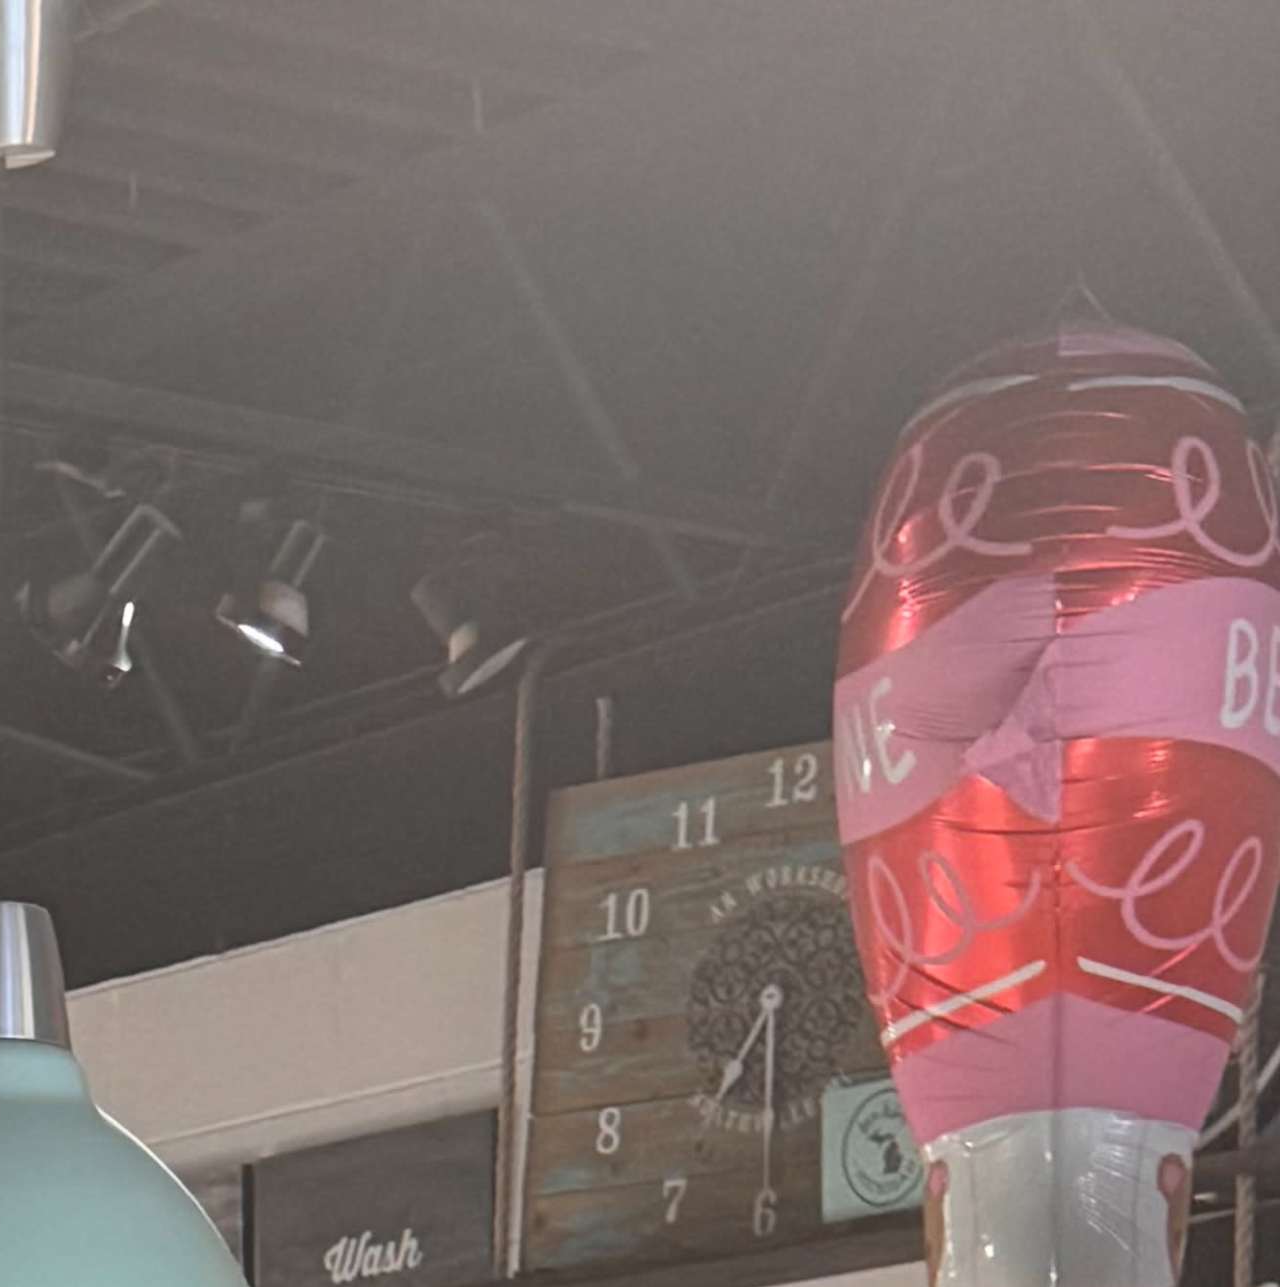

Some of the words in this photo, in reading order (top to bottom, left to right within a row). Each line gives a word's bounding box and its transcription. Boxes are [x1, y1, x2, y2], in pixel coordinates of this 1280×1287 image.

[767, 754, 817, 806] 12
[670, 797, 721, 851] 11
[596, 888, 650, 942] 10
[578, 1004, 602, 1052] 9
[595, 1106, 622, 1154] 8
[662, 1180, 688, 1223] 7
[752, 1188, 778, 1237] 6
[323, 1229, 423, 1283] Wash
